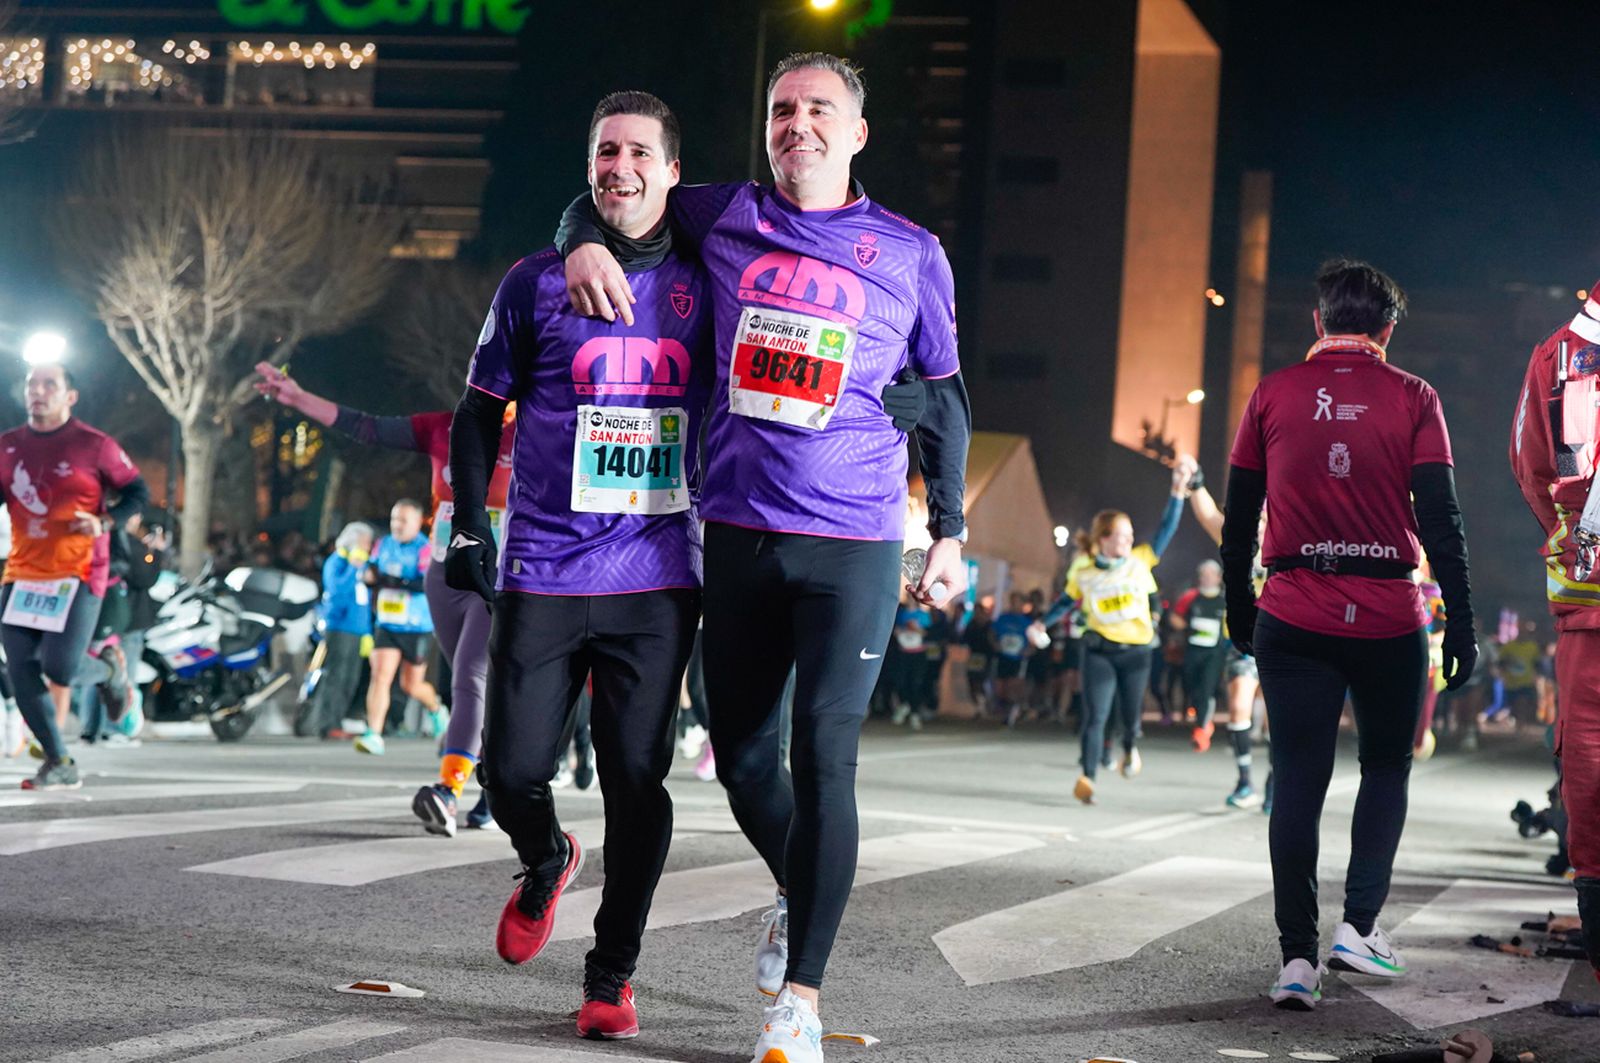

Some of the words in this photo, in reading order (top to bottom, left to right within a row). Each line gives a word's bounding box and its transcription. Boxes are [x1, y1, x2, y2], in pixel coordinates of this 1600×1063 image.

[761, 321, 794, 337] NOCHE
[795, 328, 810, 339] DE
[746, 332, 768, 345] SAN
[768, 335, 808, 352] ANTÓN
[750, 347, 823, 390] 9641
[604, 419, 640, 431] NOCHE
[642, 420, 652, 430] DE
[590, 430, 614, 442] SAN
[593, 444, 672, 478] 14041
